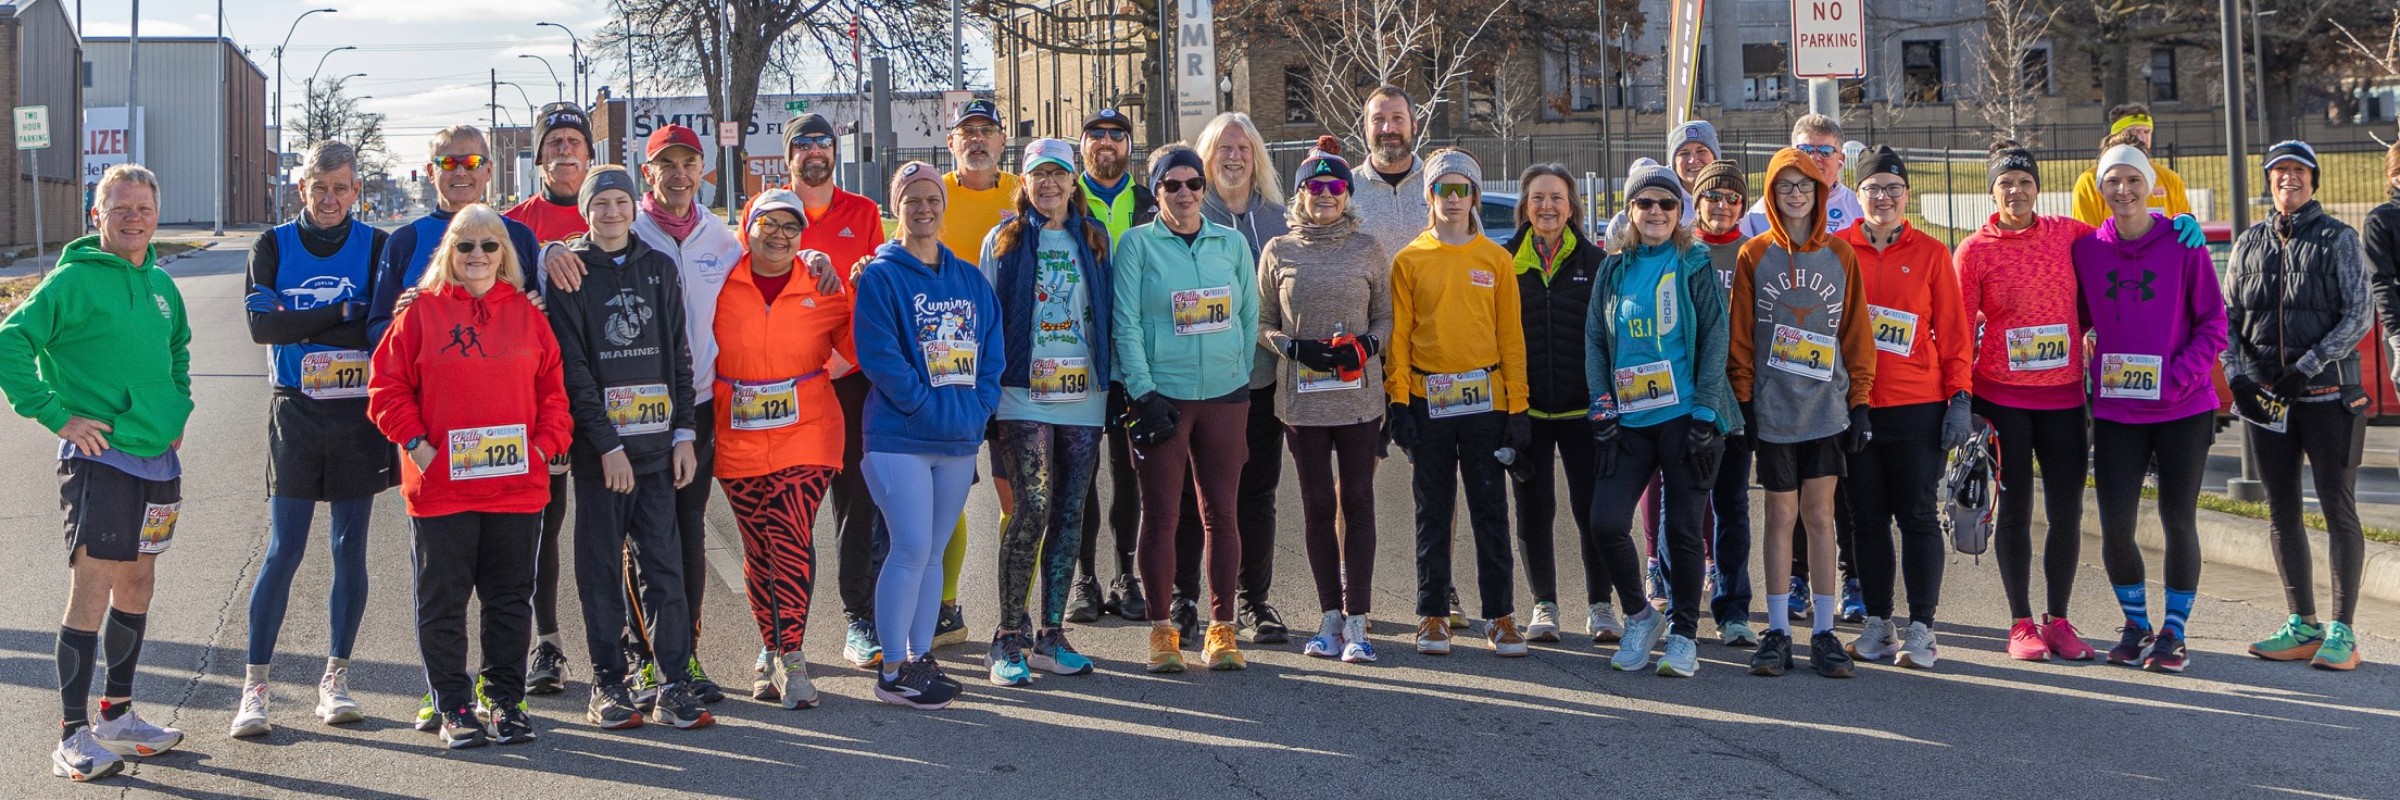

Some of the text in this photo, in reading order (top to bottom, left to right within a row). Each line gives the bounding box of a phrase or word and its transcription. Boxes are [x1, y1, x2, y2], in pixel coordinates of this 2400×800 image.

[1813, 2, 1843, 21] NO
[1800, 33, 1858, 48] PARKING
[25, 112, 38, 120] TWO
[22, 123, 42, 131] HOUR
[19, 134, 48, 142] PARKING
[914, 293, 973, 320] Running
[1664, 291, 1672, 325] 2024
[1757, 269, 1842, 328] LONGHORNS
[1206, 303, 1225, 324] 78
[1627, 318, 1653, 338] 13.1
[1877, 323, 1906, 346] 211
[600, 347, 660, 360] MARINES
[1808, 349, 1821, 369] 3
[2036, 340, 2065, 361] 224
[335, 368, 364, 389] 127
[1059, 373, 1086, 394] 139
[2123, 371, 2153, 391] 226
[1462, 386, 1481, 406] 51
[1646, 379, 1660, 400] 6
[638, 402, 666, 425] 219
[761, 399, 789, 420] 121
[485, 443, 518, 468] 128
